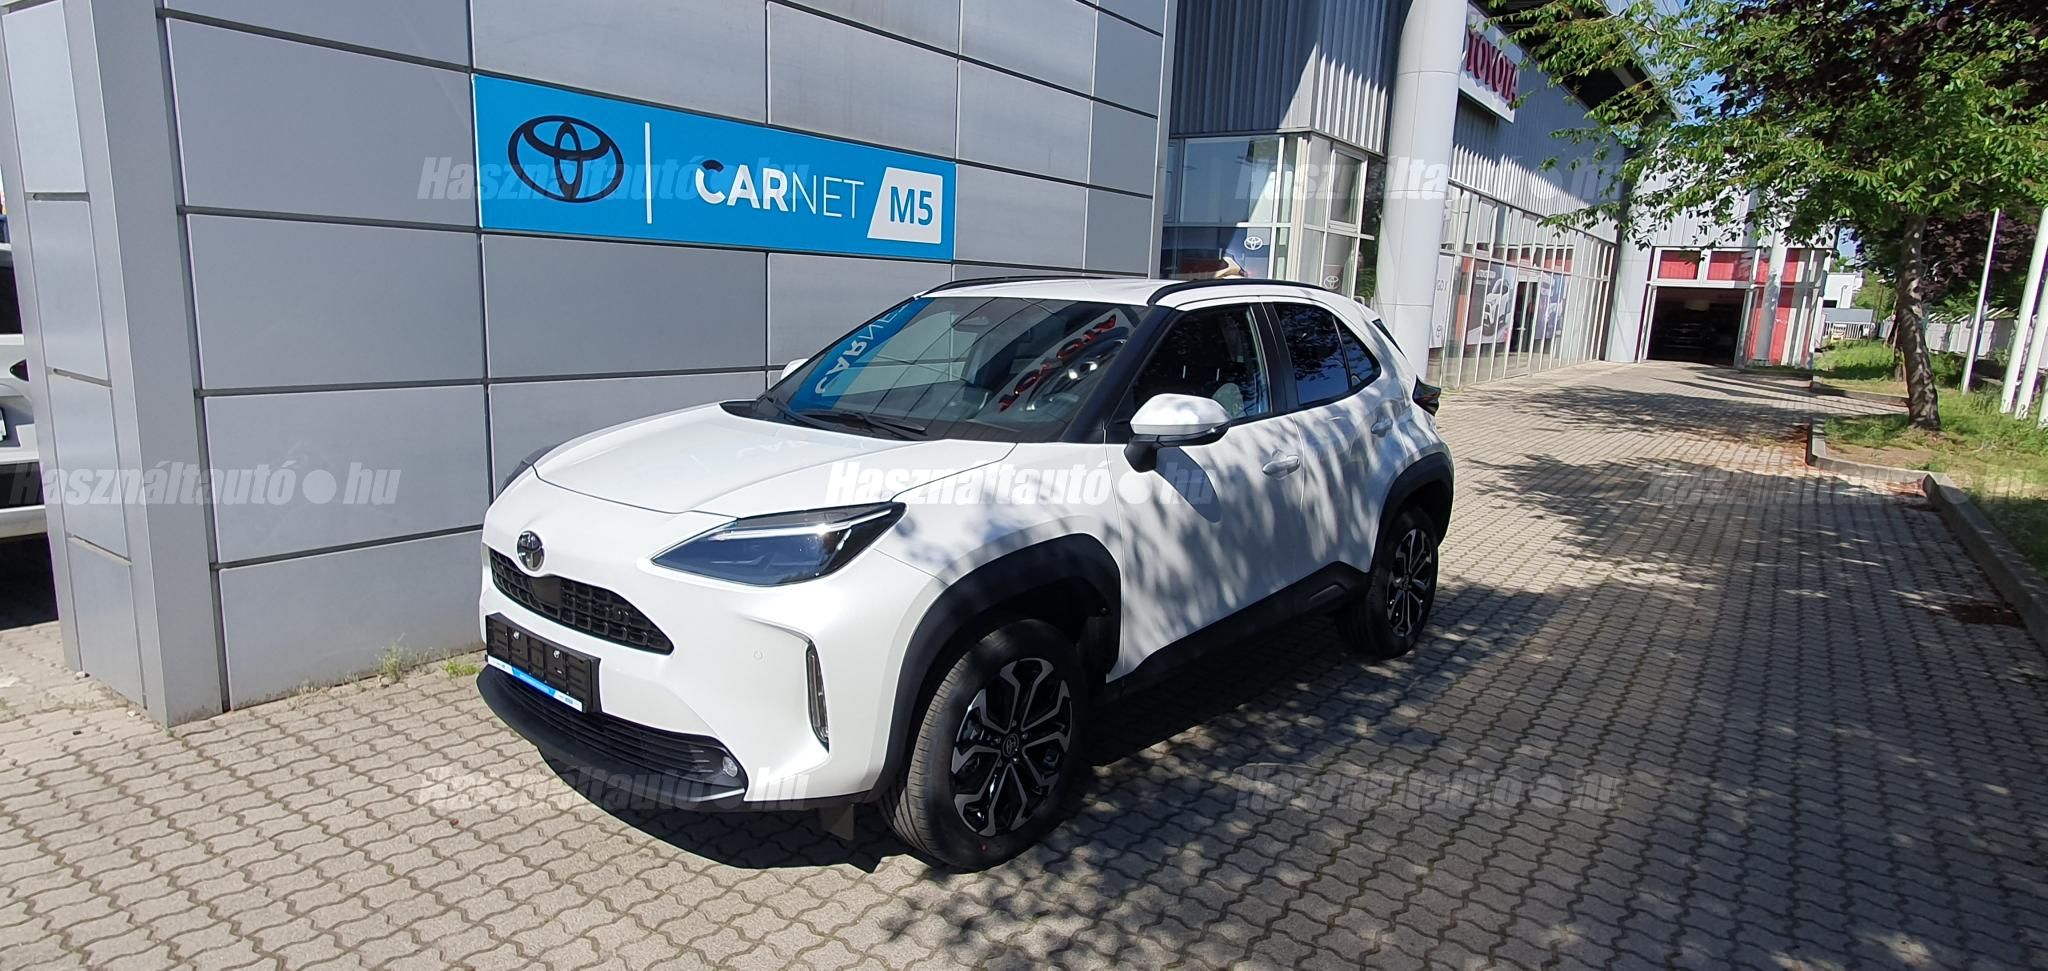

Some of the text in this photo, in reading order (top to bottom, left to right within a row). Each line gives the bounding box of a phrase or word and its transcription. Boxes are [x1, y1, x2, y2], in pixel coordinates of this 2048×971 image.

[1466, 30, 1519, 104] TOYOTA
[695, 159, 934, 226] CARNET M5
